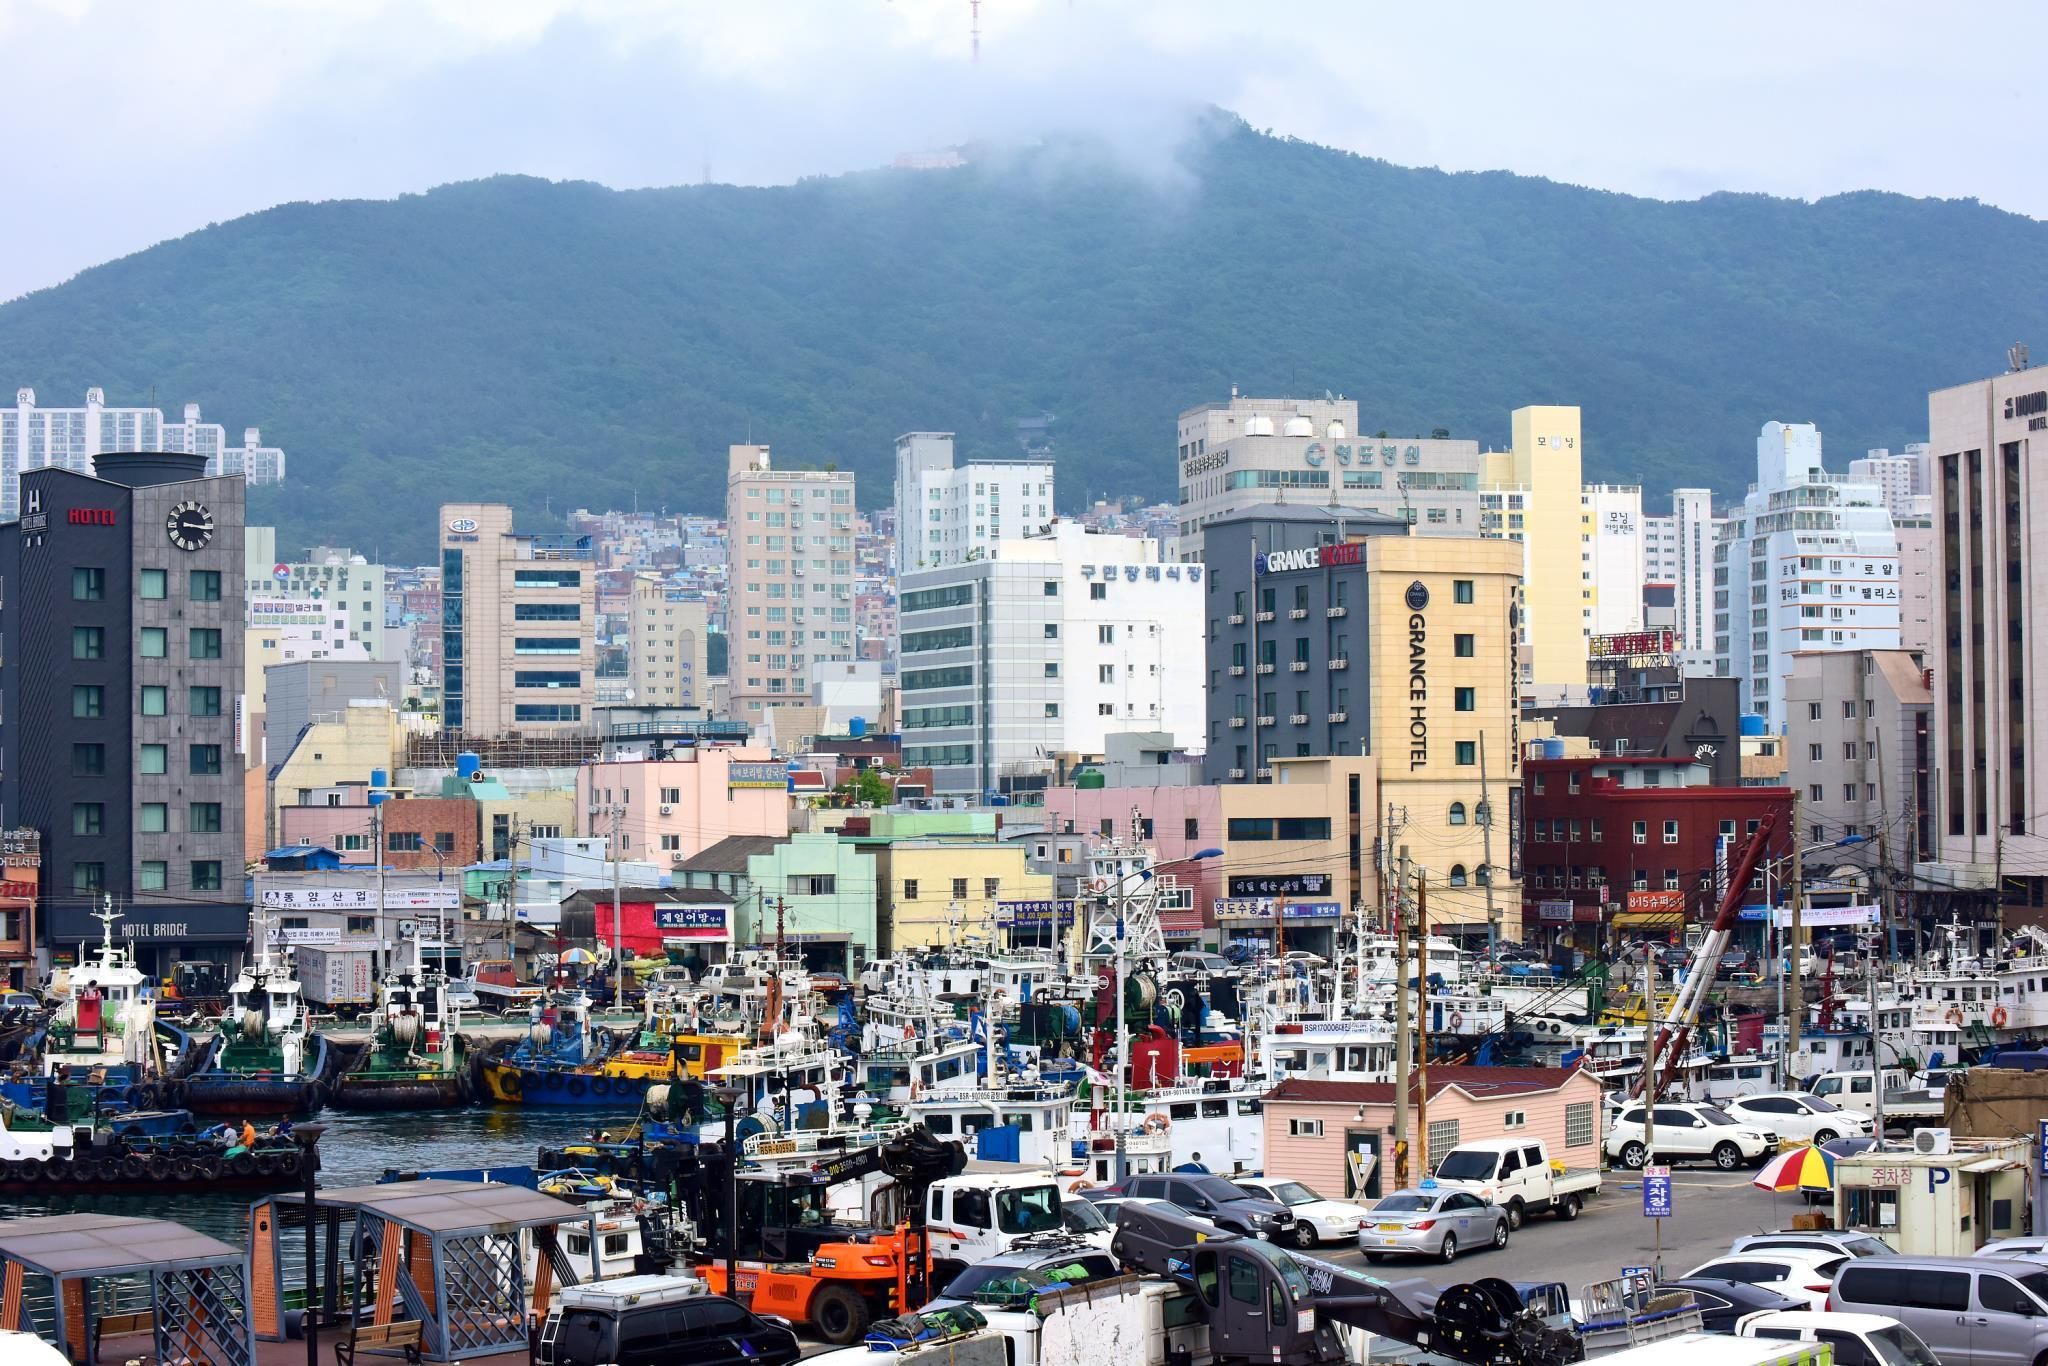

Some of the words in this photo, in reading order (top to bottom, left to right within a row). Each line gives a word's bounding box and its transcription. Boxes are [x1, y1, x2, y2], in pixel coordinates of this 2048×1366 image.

[2016, 391, 2047, 416] HOUND
[2028, 416, 2048, 431] HOTEL
[1335, 444, 1420, 466] 영도병원
[68, 507, 116, 526] HOTEL
[1610, 512, 1628, 524] 모닝
[1267, 547, 1320, 572] GRANCE
[1320, 543, 1361, 567] HOTEL
[1080, 564, 1204, 582] 구민장례식장
[1864, 564, 1893, 576] 로얄
[1862, 588, 1896, 600] 팰리스
[1409, 613, 1426, 701] GRANCE
[1510, 631, 1518, 709] GRANCE
[1410, 706, 1427, 772] HOTEL
[1694, 744, 1717, 760] MOTEL
[3, 843, 26, 854] 전국
[284, 891, 366, 902] 동양산업
[662, 912, 709, 922] 제일어망
[1215, 902, 1258, 915] 영도수중
[122, 924, 150, 936] HOTEL
[154, 922, 188, 936] BRIDGE
[1872, 1167, 1912, 1185] 주차장
[1928, 1167, 1950, 1194] P
[1648, 1178, 1668, 1206] 주차장
